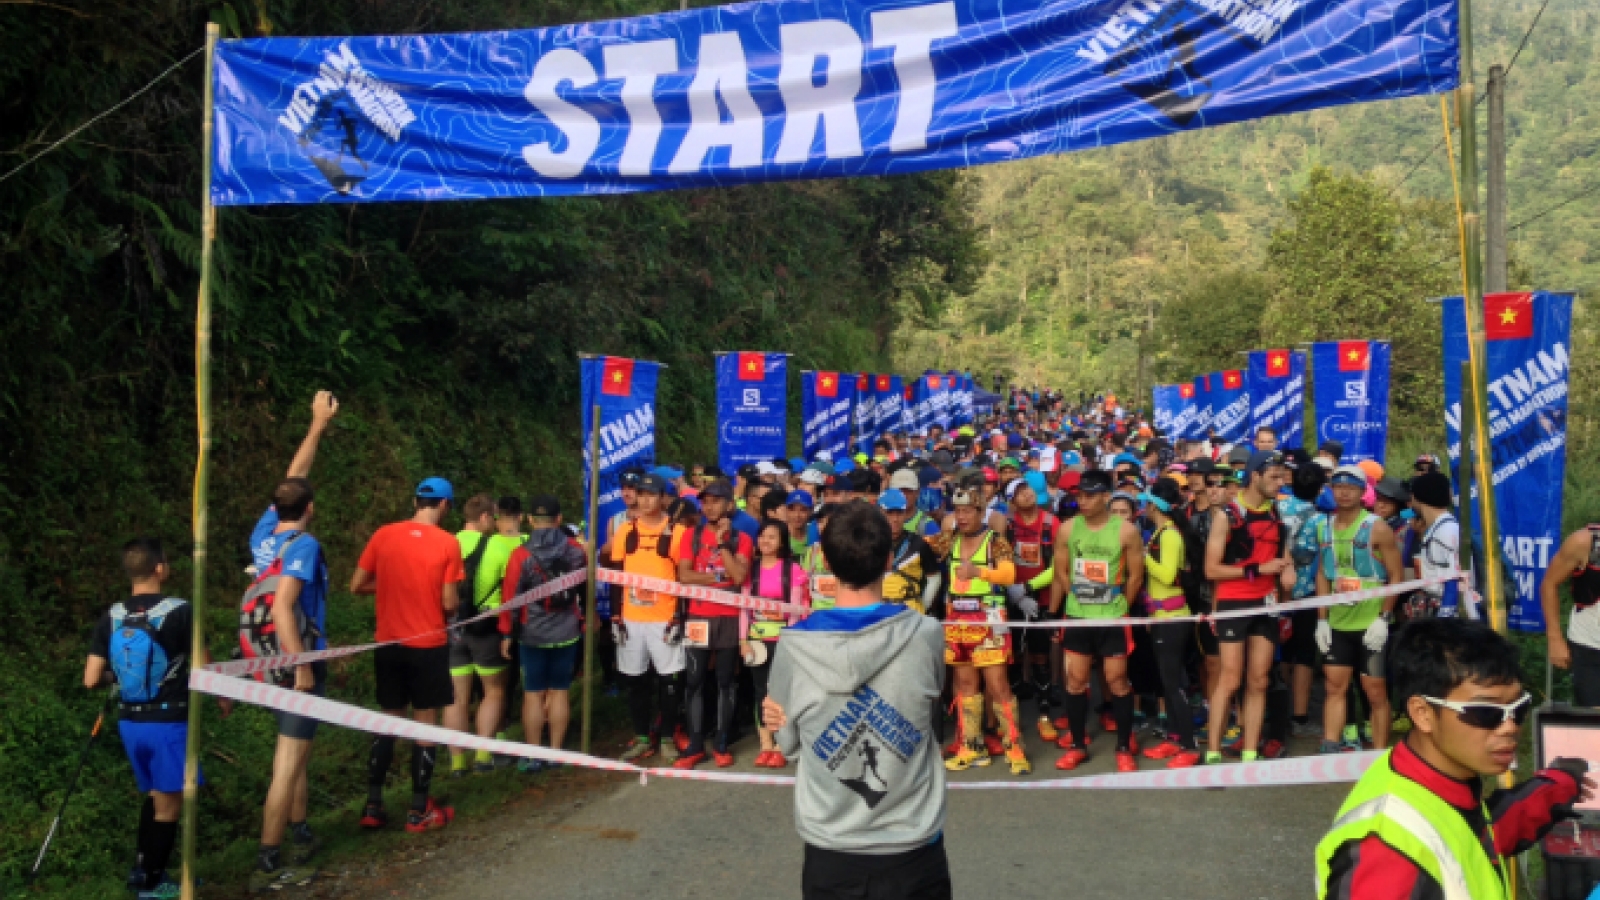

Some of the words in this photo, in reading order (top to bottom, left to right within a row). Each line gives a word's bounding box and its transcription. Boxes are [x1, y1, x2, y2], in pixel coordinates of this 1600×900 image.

[278, 42, 359, 134] VIETNAM
[522, 1, 957, 178] START
[1444, 342, 1568, 432] VTNAM
[1498, 535, 1554, 568] ART
[811, 683, 880, 761] VIETNAM
